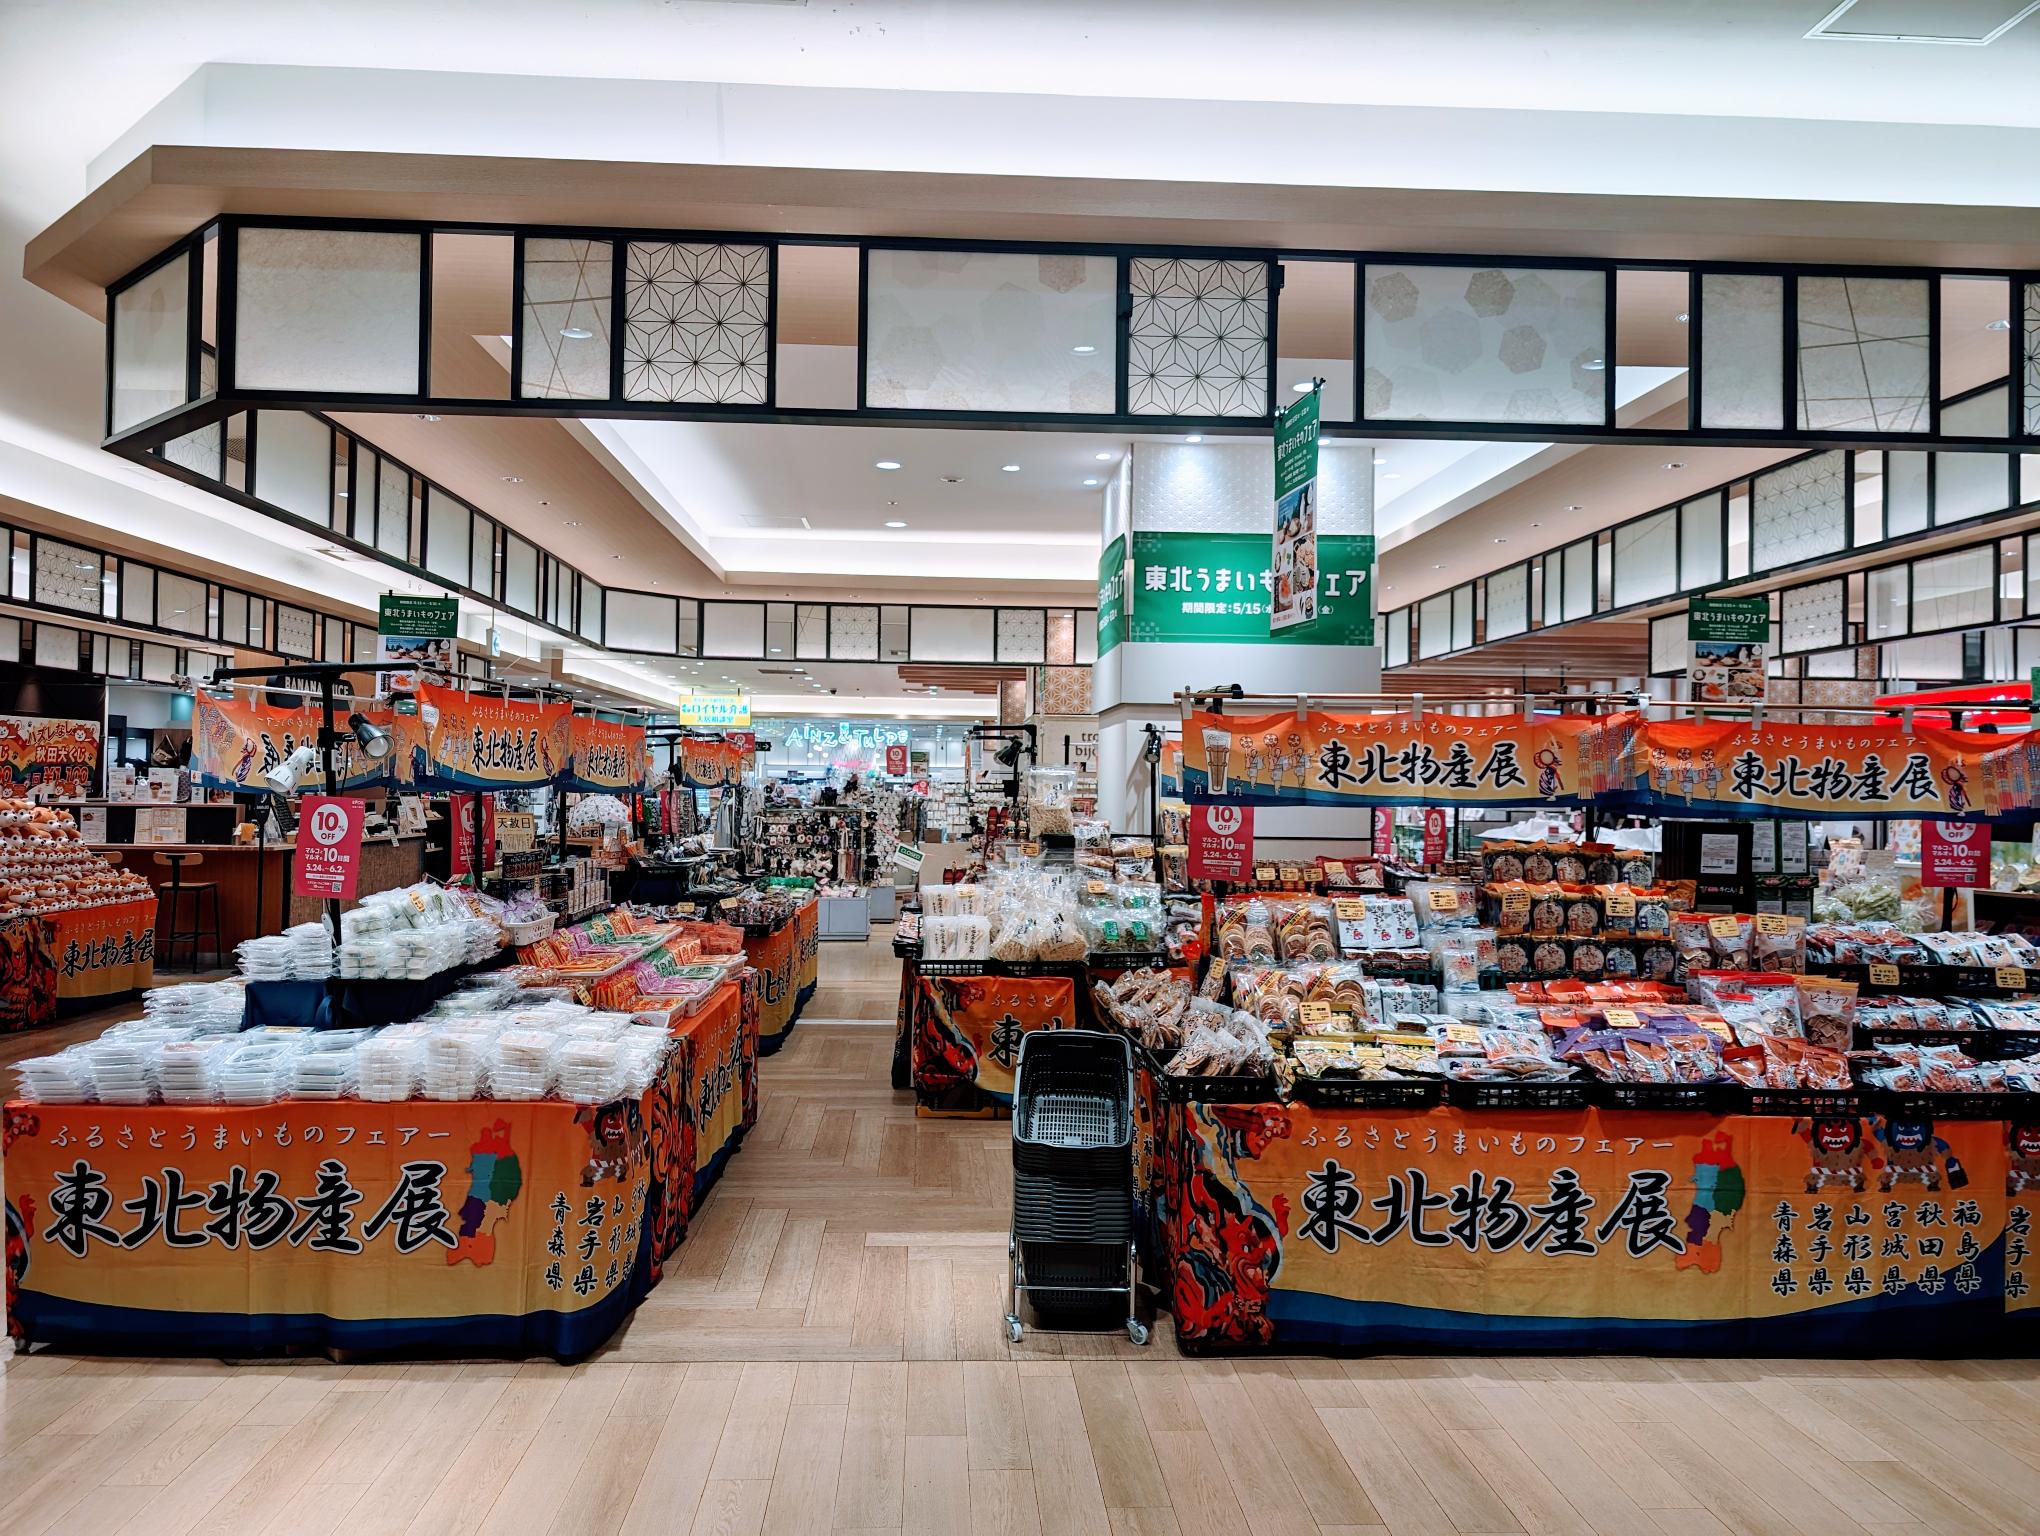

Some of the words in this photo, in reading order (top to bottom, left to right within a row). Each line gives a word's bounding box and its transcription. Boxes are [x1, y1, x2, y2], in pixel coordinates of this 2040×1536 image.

[384, 608, 455, 621] 東北うまいものフェア
[1693, 611, 1767, 624] 東北うまいものフェア
[26, 721, 74, 746] ハズレなし
[471, 723, 540, 775] 東北物産展
[785, 727, 838, 748] AINZ
[1318, 720, 1519, 737] ふるさとうまいものフェアー
[1732, 732, 1928, 750] ふるさとうまいものフェアー
[36, 746, 87, 764] 秋田犬くじ
[586, 743, 626, 780] 東北物産展
[1316, 739, 1528, 789] 東北物産展
[1730, 749, 1941, 801] 東北物産展
[60, 927, 155, 979] 東北物産展
[51, 1120, 452, 1152] ふるさとうまいものフェアー
[1301, 1125, 1675, 1156] ふるさとうまいものフェアー
[45, 1159, 459, 1259] 東北物産展
[1296, 1159, 1687, 1258] 東北物産展
[547, 1191, 573, 1292] 青森県
[572, 1195, 605, 1297] 岩手県
[604, 1193, 626, 1290] 山形県
[1771, 1202, 1800, 1297] 青森県
[1806, 1202, 1834, 1297] 岩手県
[1843, 1203, 1873, 1296] 山形県
[1880, 1201, 1910, 1295] 宮城県
[1916, 1201, 1949, 1295] 秋田県
[1952, 1200, 1983, 1293] 福島県
[2004, 1205, 2032, 1300] 岩手県
